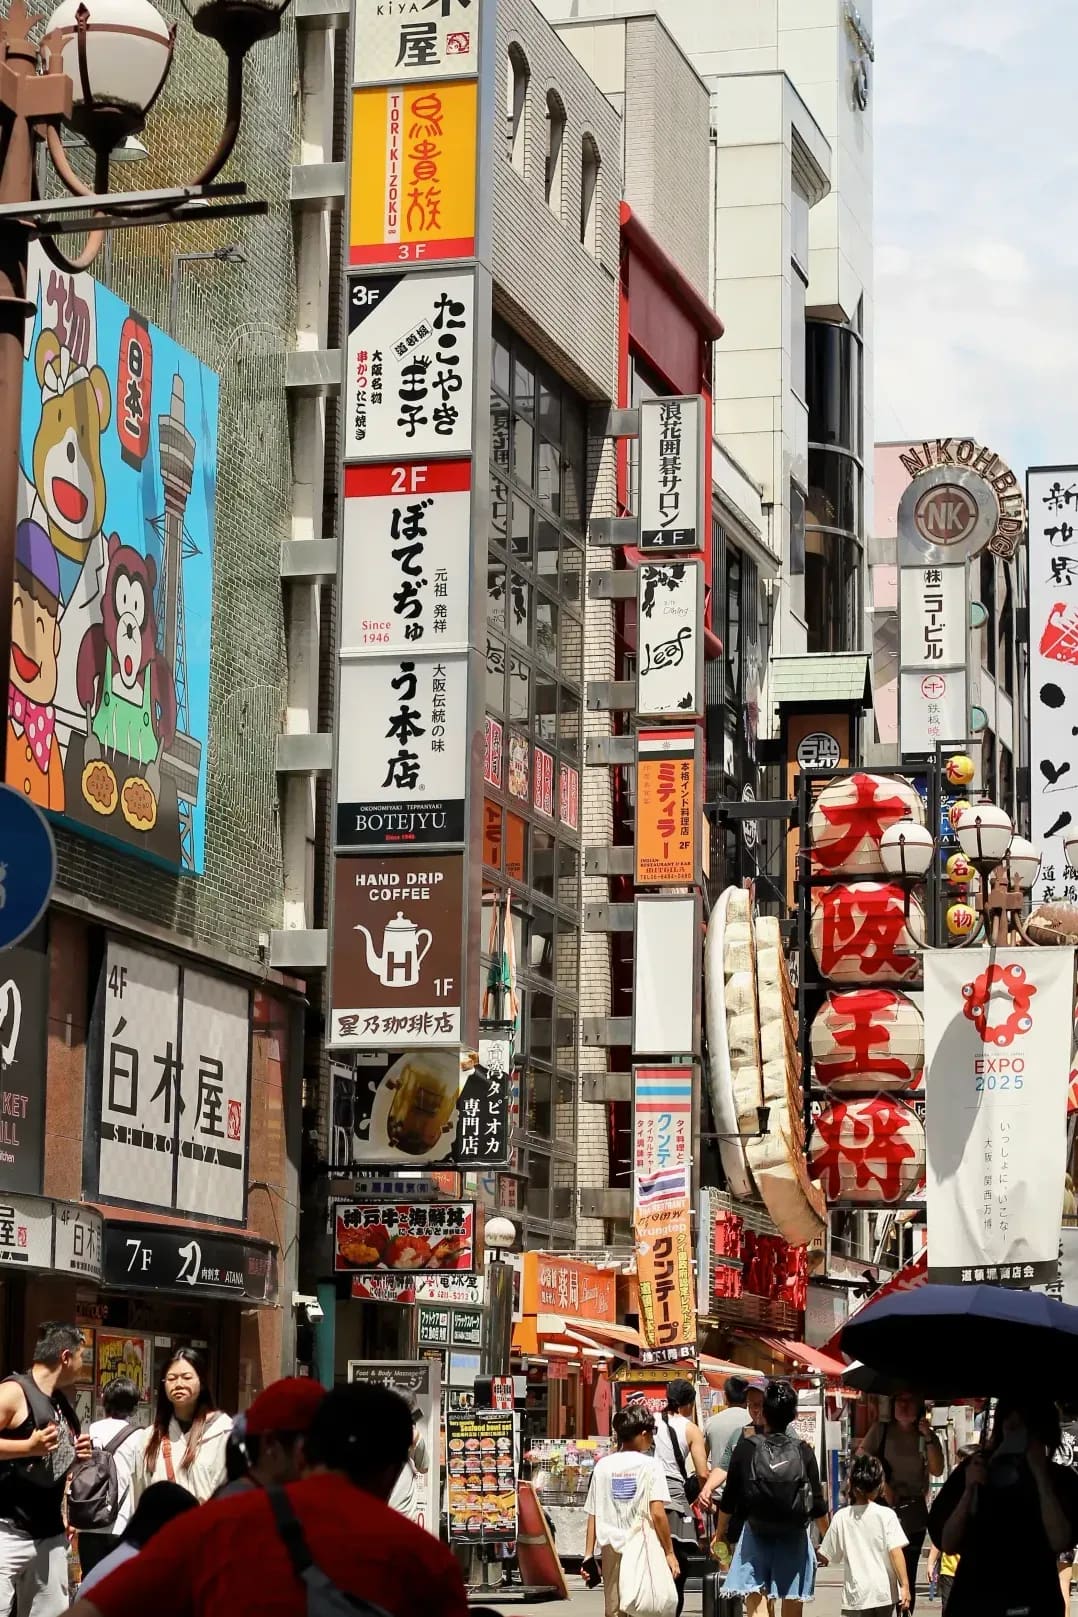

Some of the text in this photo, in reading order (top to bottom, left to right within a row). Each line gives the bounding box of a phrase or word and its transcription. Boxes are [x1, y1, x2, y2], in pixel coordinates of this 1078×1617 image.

[388, 95, 400, 226] TORIKIZOKU
[398, 244, 426, 260] 3F
[352, 286, 380, 306] 3F
[371, 350, 383, 405] 大阪名物
[432, 292, 466, 436] たこやき
[125, 339, 144, 438] 日本一
[397, 360, 429, 438] 王子
[390, 466, 428, 493] 2F
[658, 402, 683, 529] 浪花囲碁サロン
[926, 502, 964, 530] NK
[433, 567, 448, 634] 元祖 発祥
[362, 620, 392, 631] Since
[362, 632, 390, 643] 1946
[641, 627, 692, 676] Leaf
[431, 663, 447, 753] 大阪伝統の味
[656, 762, 676, 860] ミティラー
[680, 762, 690, 836] 本格インド料理店
[679, 841, 691, 850] 2F
[355, 872, 444, 887] HAND DRIP
[369, 888, 430, 901] COFFEE
[107, 965, 128, 999] 4F
[385, 951, 413, 982] H
[433, 978, 454, 997] 1F
[337, 1010, 456, 1038] 星乃珈琲店
[107, 1015, 226, 1139] 白木屋
[974, 1058, 1025, 1075] EXPO
[975, 1075, 1024, 1092] 2025
[461, 1098, 481, 1156] 専門店
[656, 1113, 672, 1168] クンテ
[126, 1239, 152, 1272] 7F
[961, 1265, 1034, 1282] 道頓堀商店会
[653, 1236, 679, 1345] クンテープ
